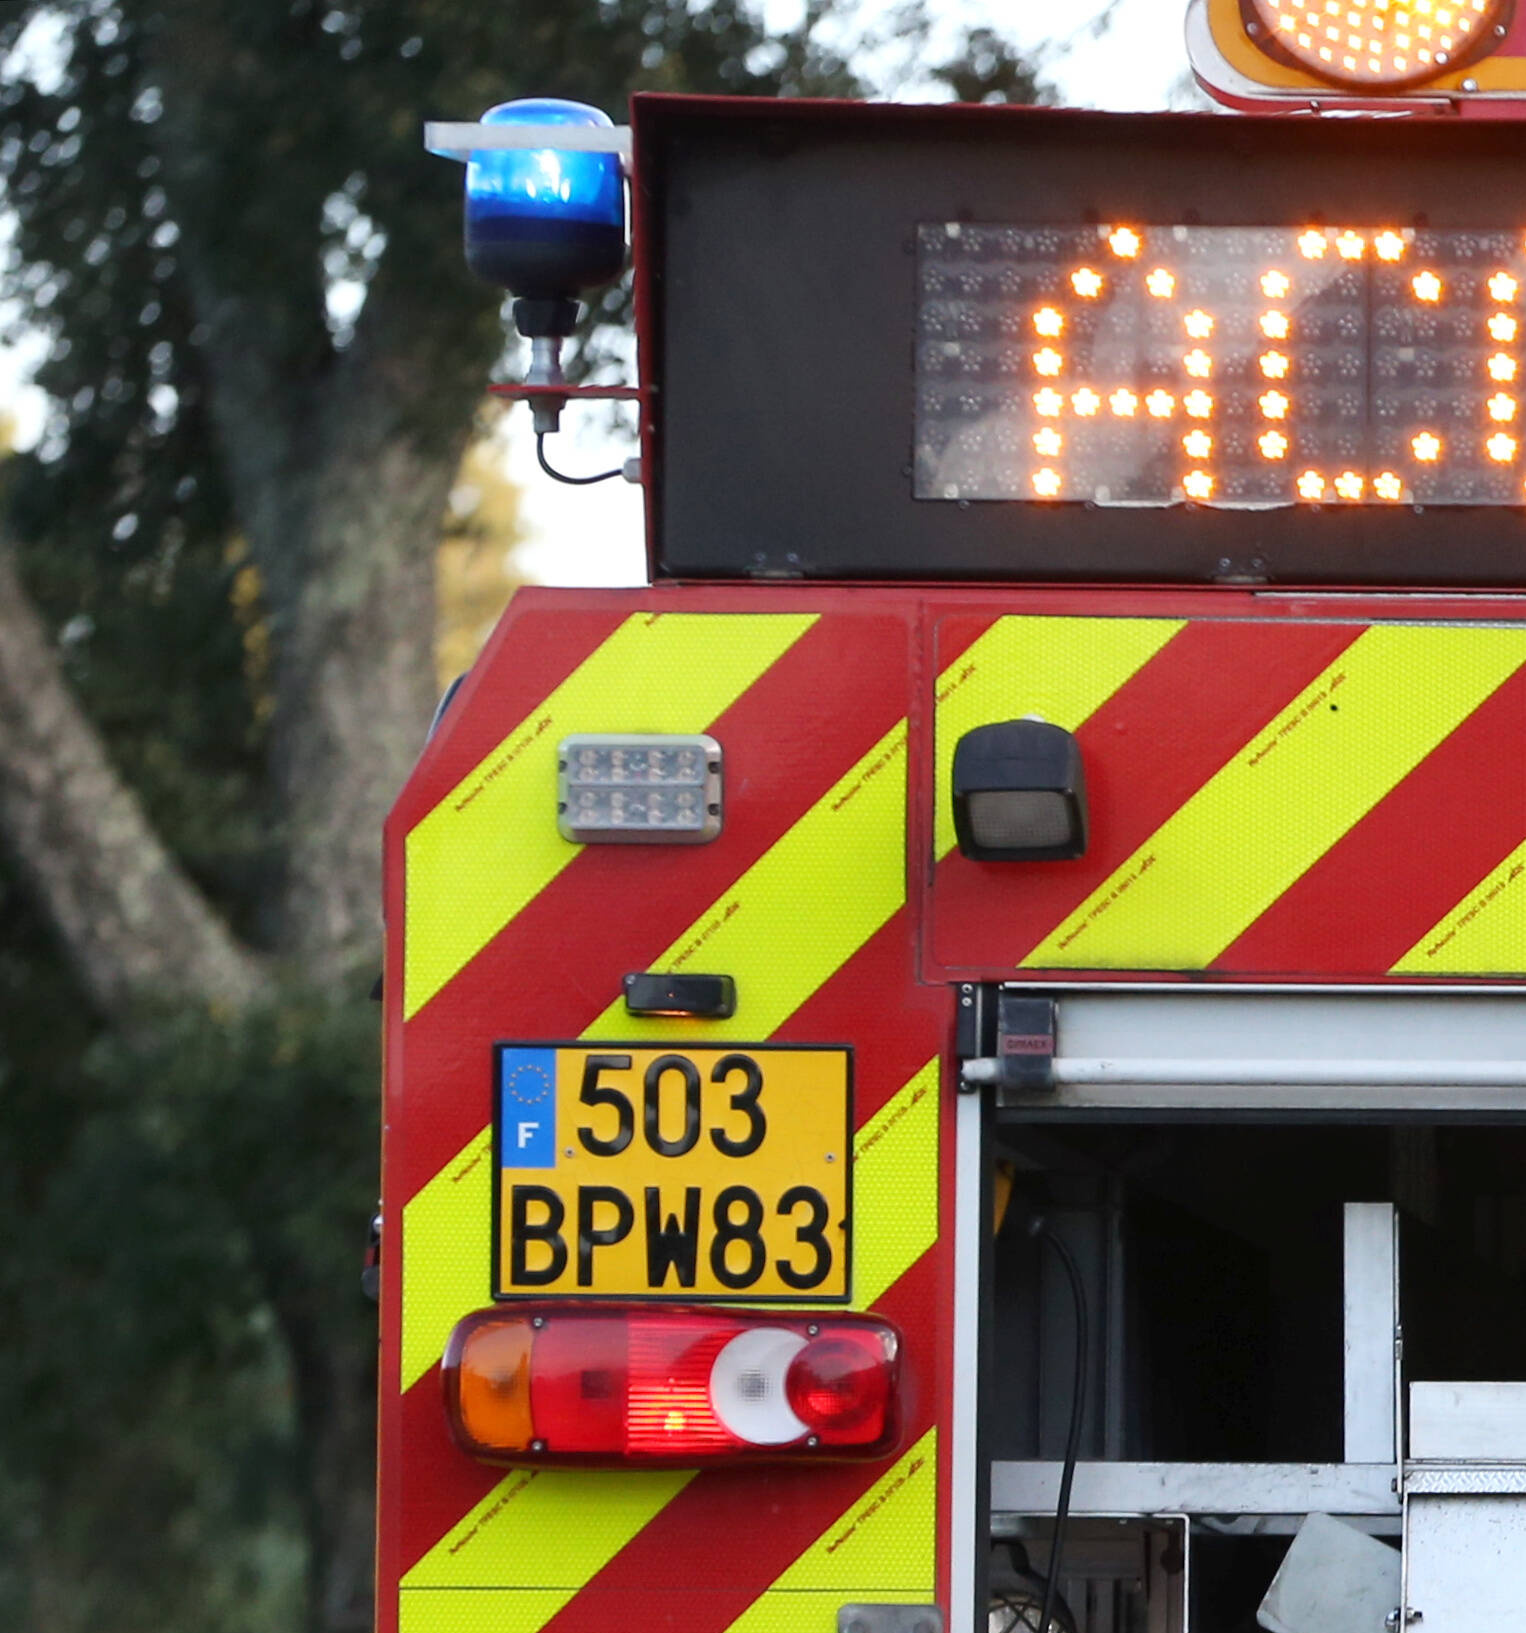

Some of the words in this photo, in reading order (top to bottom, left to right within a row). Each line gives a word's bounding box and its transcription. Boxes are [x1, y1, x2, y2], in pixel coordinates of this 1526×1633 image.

[517, 1122, 539, 1148] F
[577, 1054, 766, 1158] 503
[510, 1185, 832, 1289] BPW83
